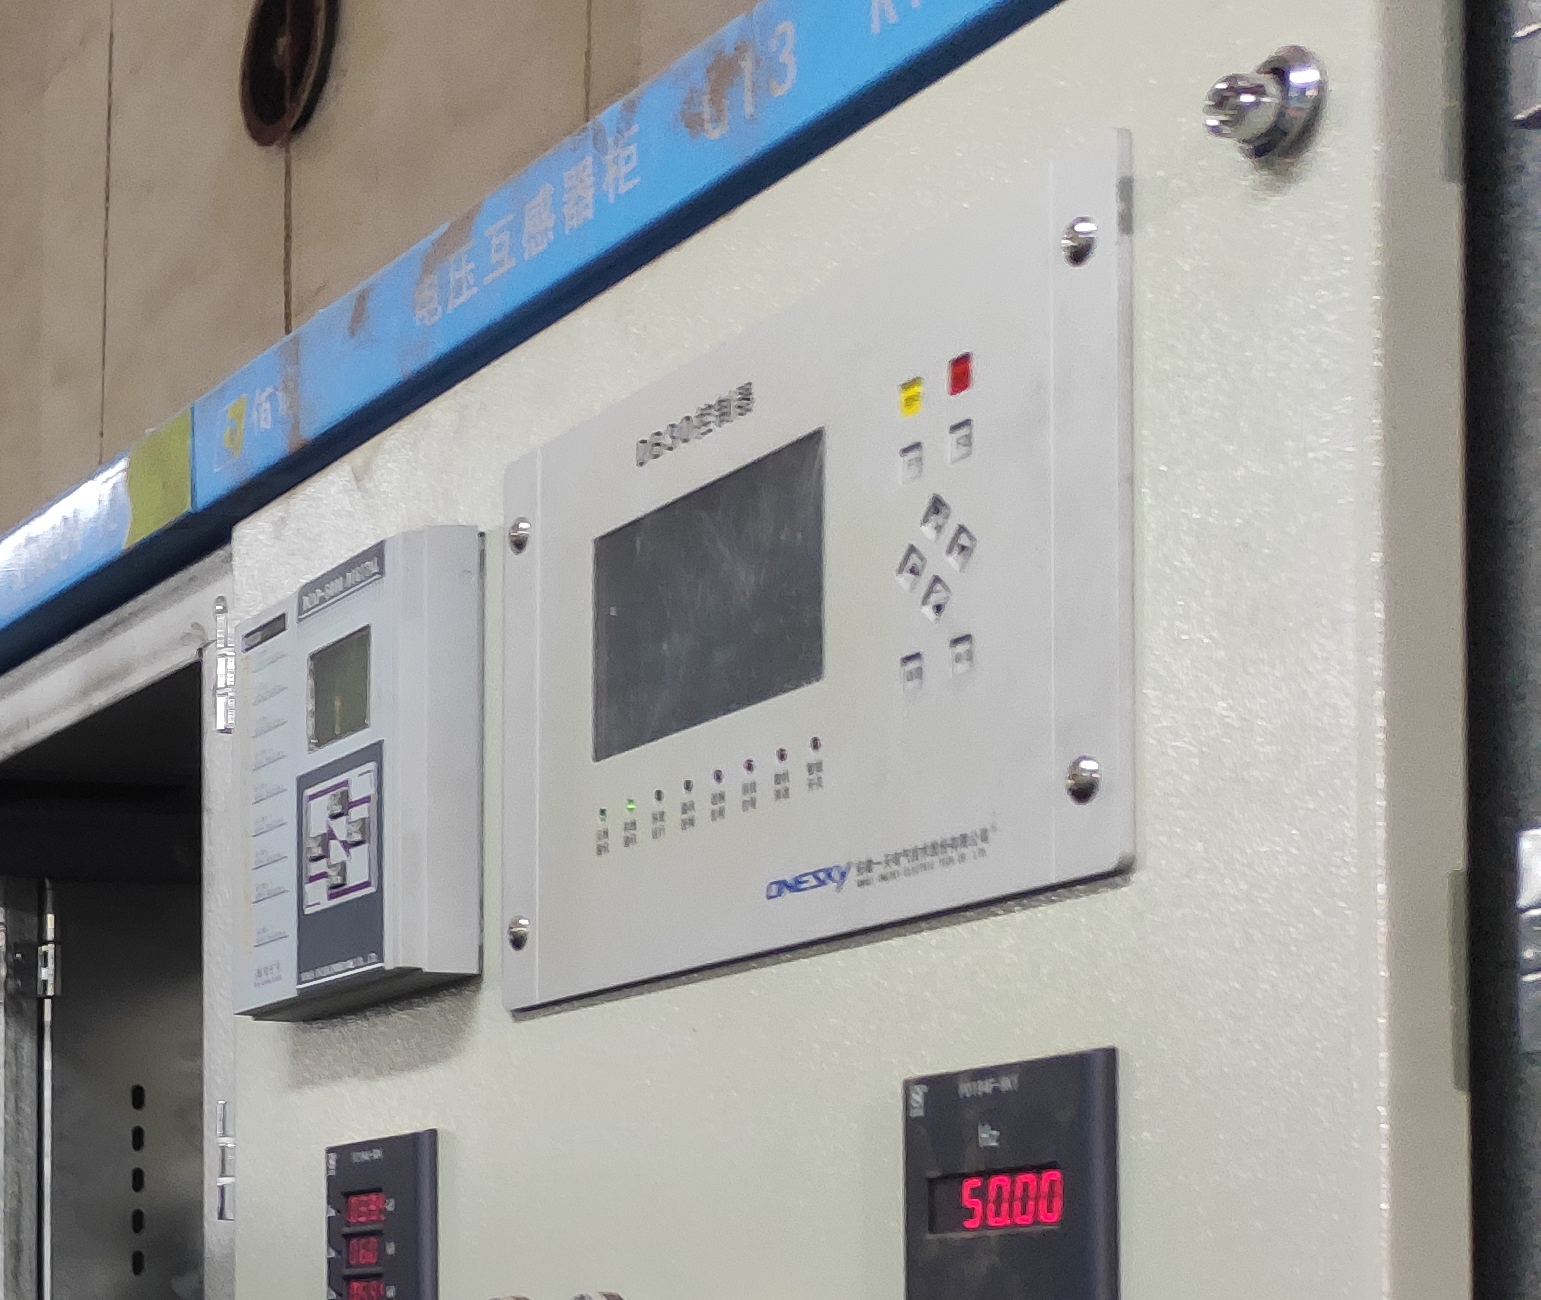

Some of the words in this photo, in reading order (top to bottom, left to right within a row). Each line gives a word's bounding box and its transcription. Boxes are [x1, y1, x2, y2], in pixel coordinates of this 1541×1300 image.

[417, 123, 641, 326] 电压互感器柜
[978, 1122, 1000, 1148] Hz
